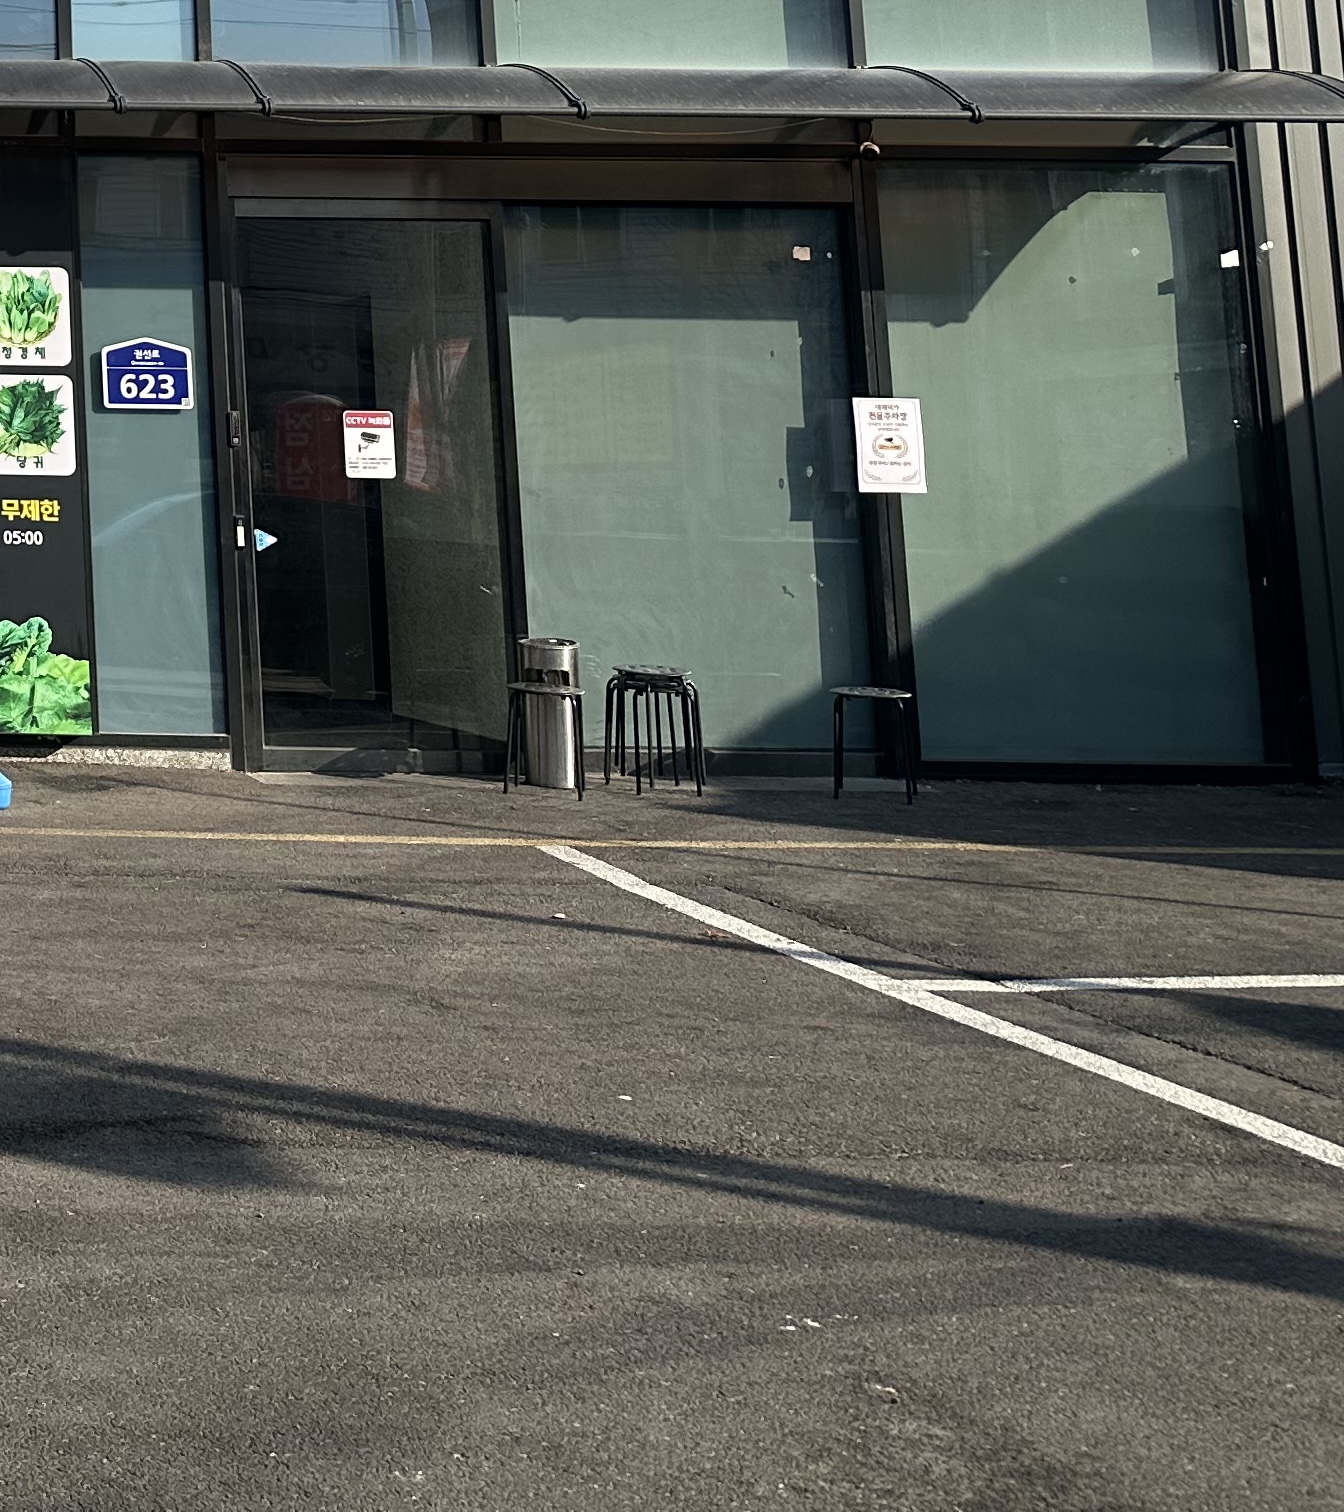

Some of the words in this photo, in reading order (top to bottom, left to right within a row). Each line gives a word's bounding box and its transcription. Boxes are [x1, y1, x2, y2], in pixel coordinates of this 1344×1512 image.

[120, 373, 175, 399] 623
[0, 499, 60, 522] 무제한
[3, 530, 44, 546] 05:00
